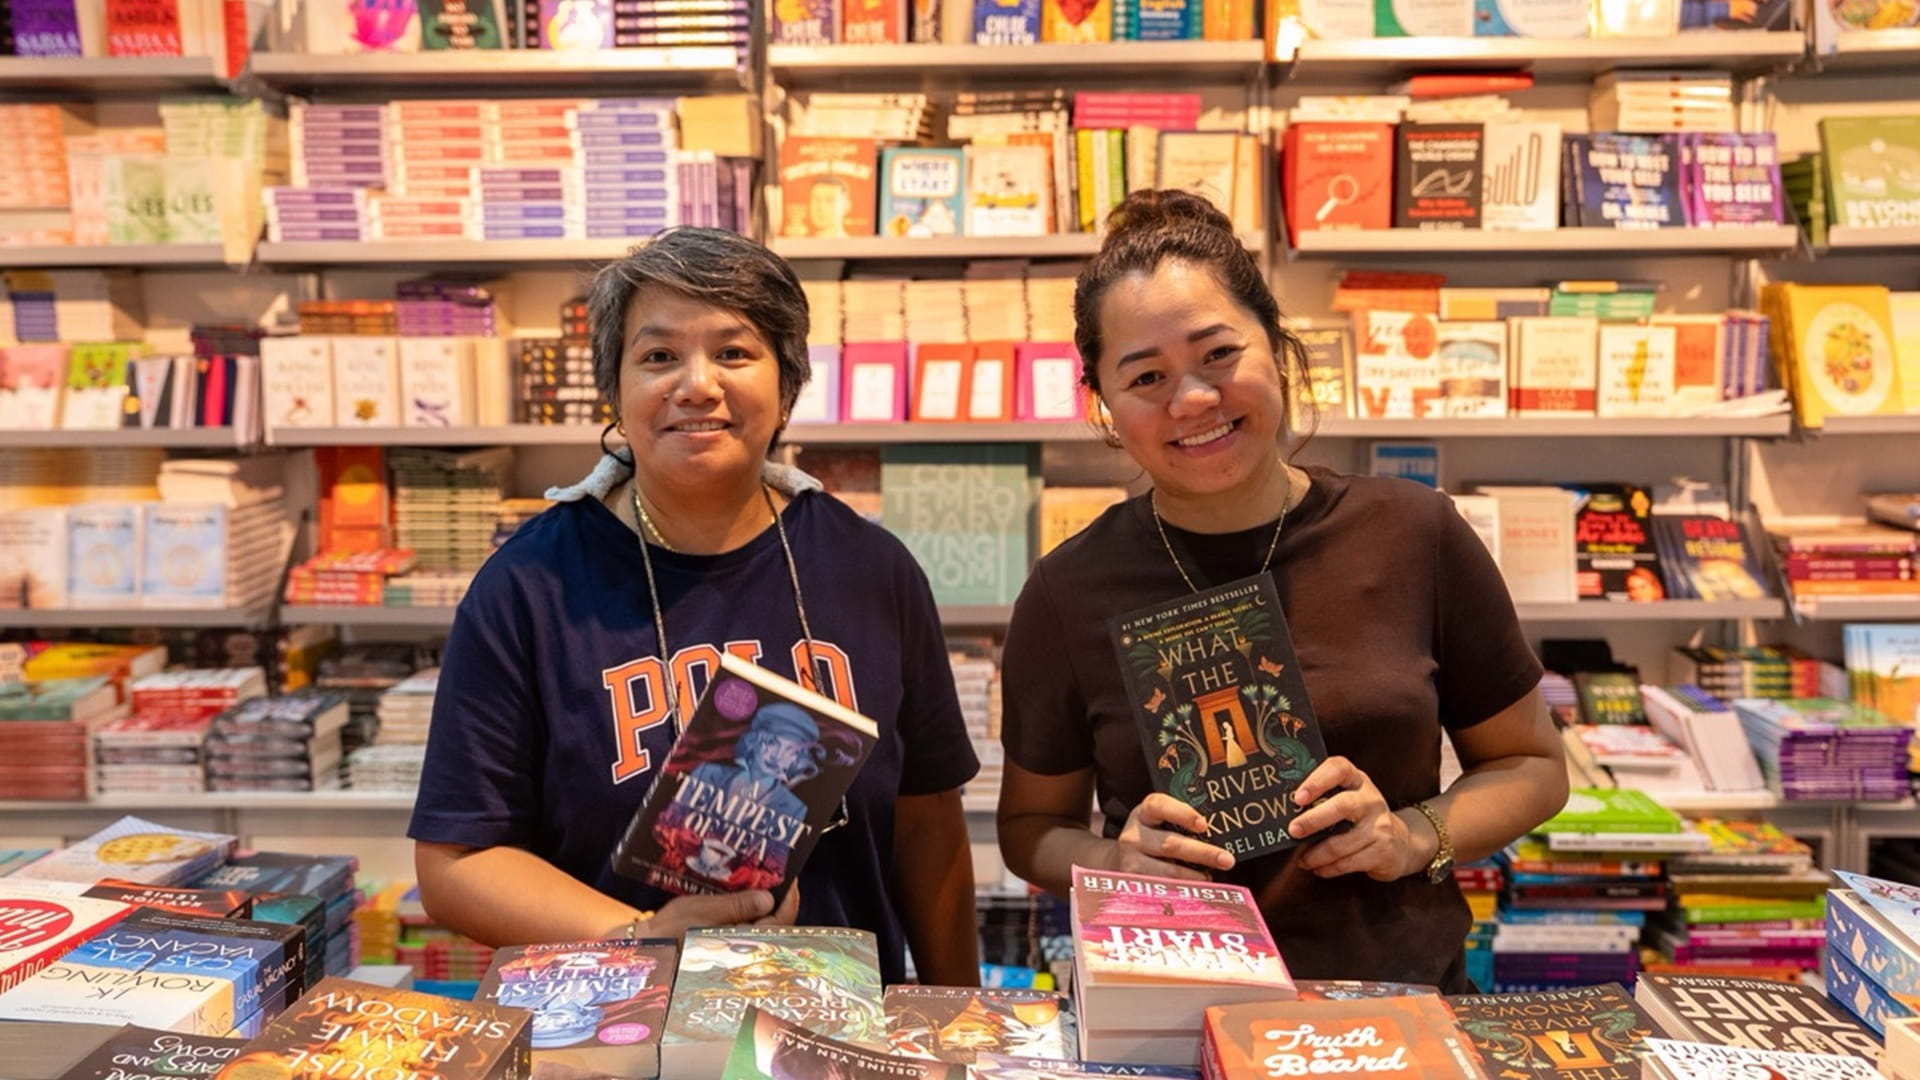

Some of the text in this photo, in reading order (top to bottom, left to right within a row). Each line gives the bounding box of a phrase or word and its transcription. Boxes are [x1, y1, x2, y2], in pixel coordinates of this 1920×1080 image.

[1134, 616, 1153, 629] NEW
[1156, 608, 1180, 622] YORK
[1182, 599, 1209, 614] TIMES
[1210, 583, 1260, 606] BESTSELLER
[1158, 626, 1241, 669] WHAT
[1182, 661, 1239, 695] THE
[1205, 763, 1282, 803] RIVER
[674, 772, 812, 850] TEMPEST
[684, 813, 716, 844] OF
[721, 822, 769, 862] TEA
[120, 894, 203, 908] KAYVION
[141, 889, 200, 901] LEWIS
[1083, 875, 1246, 904] ELSIE SILVER
[92, 931, 255, 959] VACANCY
[1108, 925, 1246, 955] START
[92, 944, 234, 972] CASUAL
[40, 966, 215, 993] ROWLING
[487, 976, 655, 1001] TEMPEST
[897, 986, 936, 996] LIM
[1670, 976, 1802, 994] ZUSAK MARKUS
[702, 995, 848, 1010] PROMISE
[1481, 998, 1596, 1018] KNOWS
[1535, 986, 1604, 1002] ISABEL
[310, 991, 512, 1040] SHADOW
[1508, 1014, 1592, 1031] RIVER
[1670, 986, 1860, 1032] THIEF
[312, 1020, 460, 1064] FLAME
[368, 1019, 420, 1038] AND
[112, 1053, 155, 1068] AND
[770, 1031, 930, 1079] ADELINE YEN MAH
[1027, 1059, 1146, 1076] AVA REID
[1263, 1046, 1409, 1078] Beard
